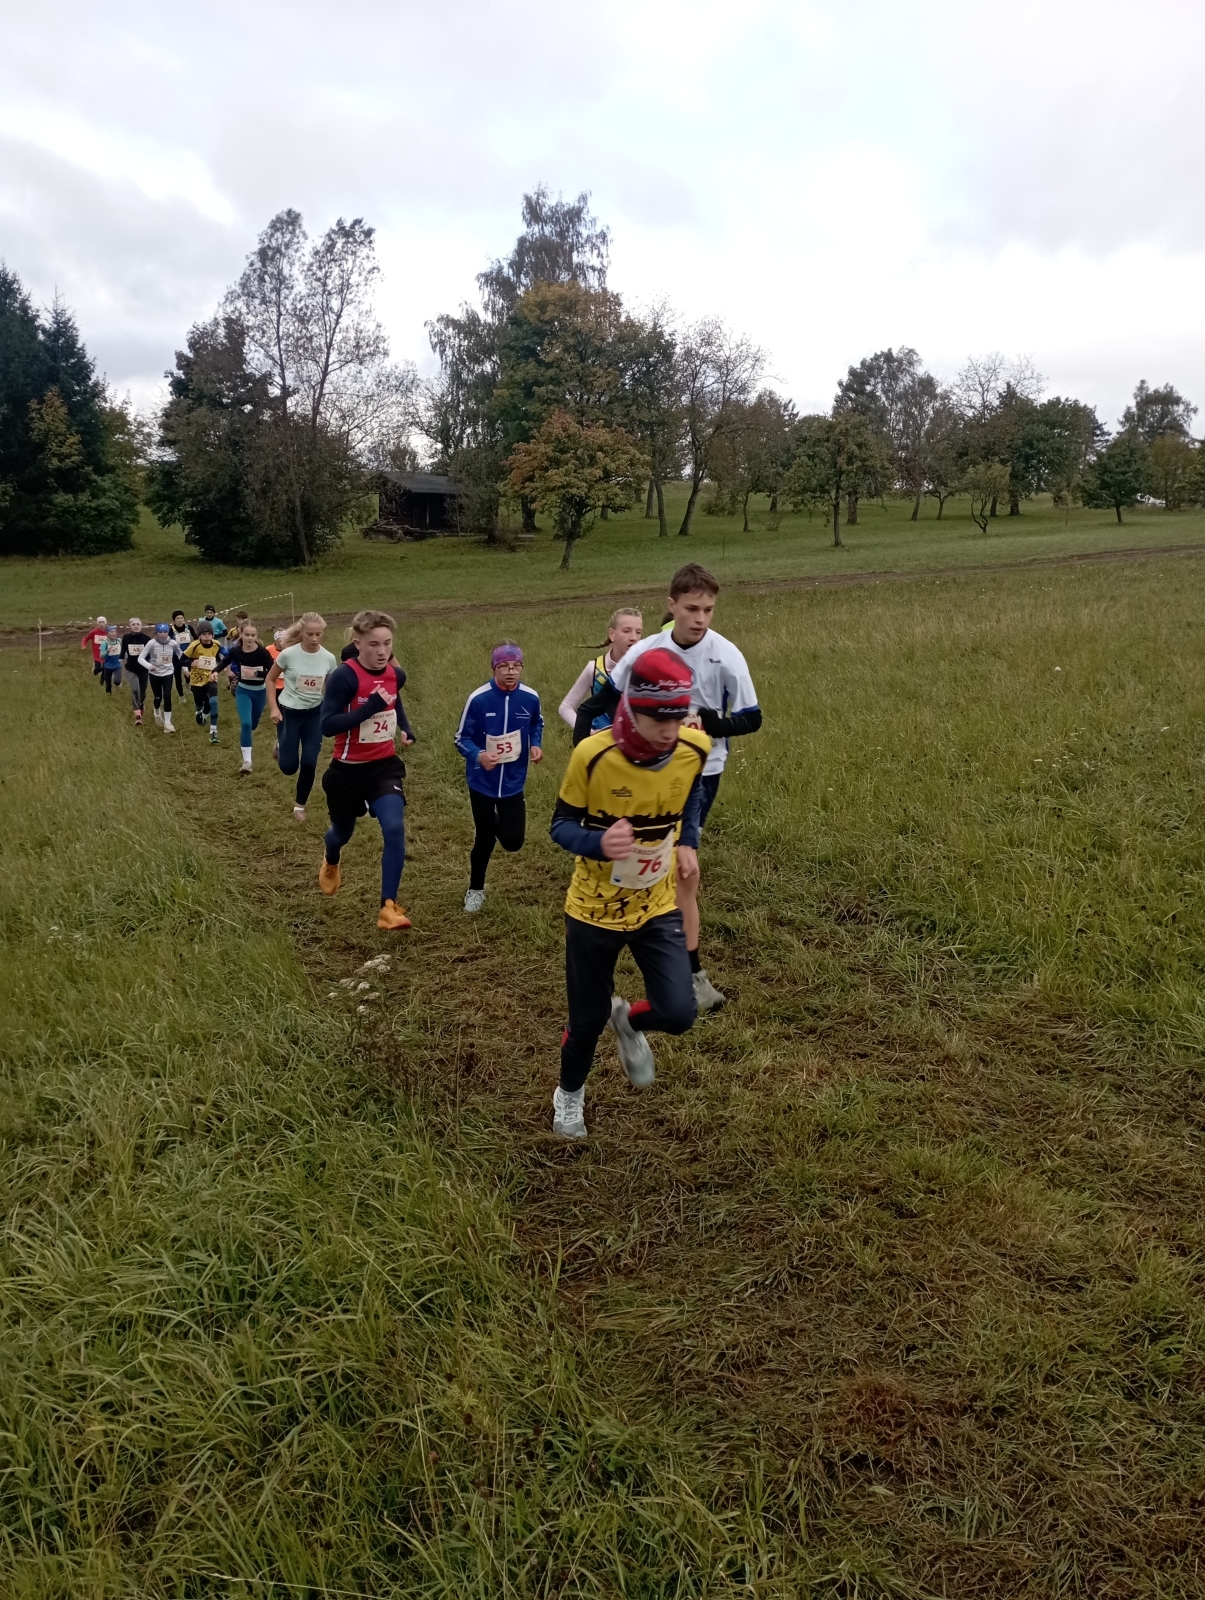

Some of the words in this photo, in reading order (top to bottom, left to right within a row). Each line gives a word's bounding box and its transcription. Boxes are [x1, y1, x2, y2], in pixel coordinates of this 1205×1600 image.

[303, 679, 316, 687] 46
[373, 720, 388, 734] 24
[496, 742, 513, 755] 53
[637, 854, 662, 876] 76
